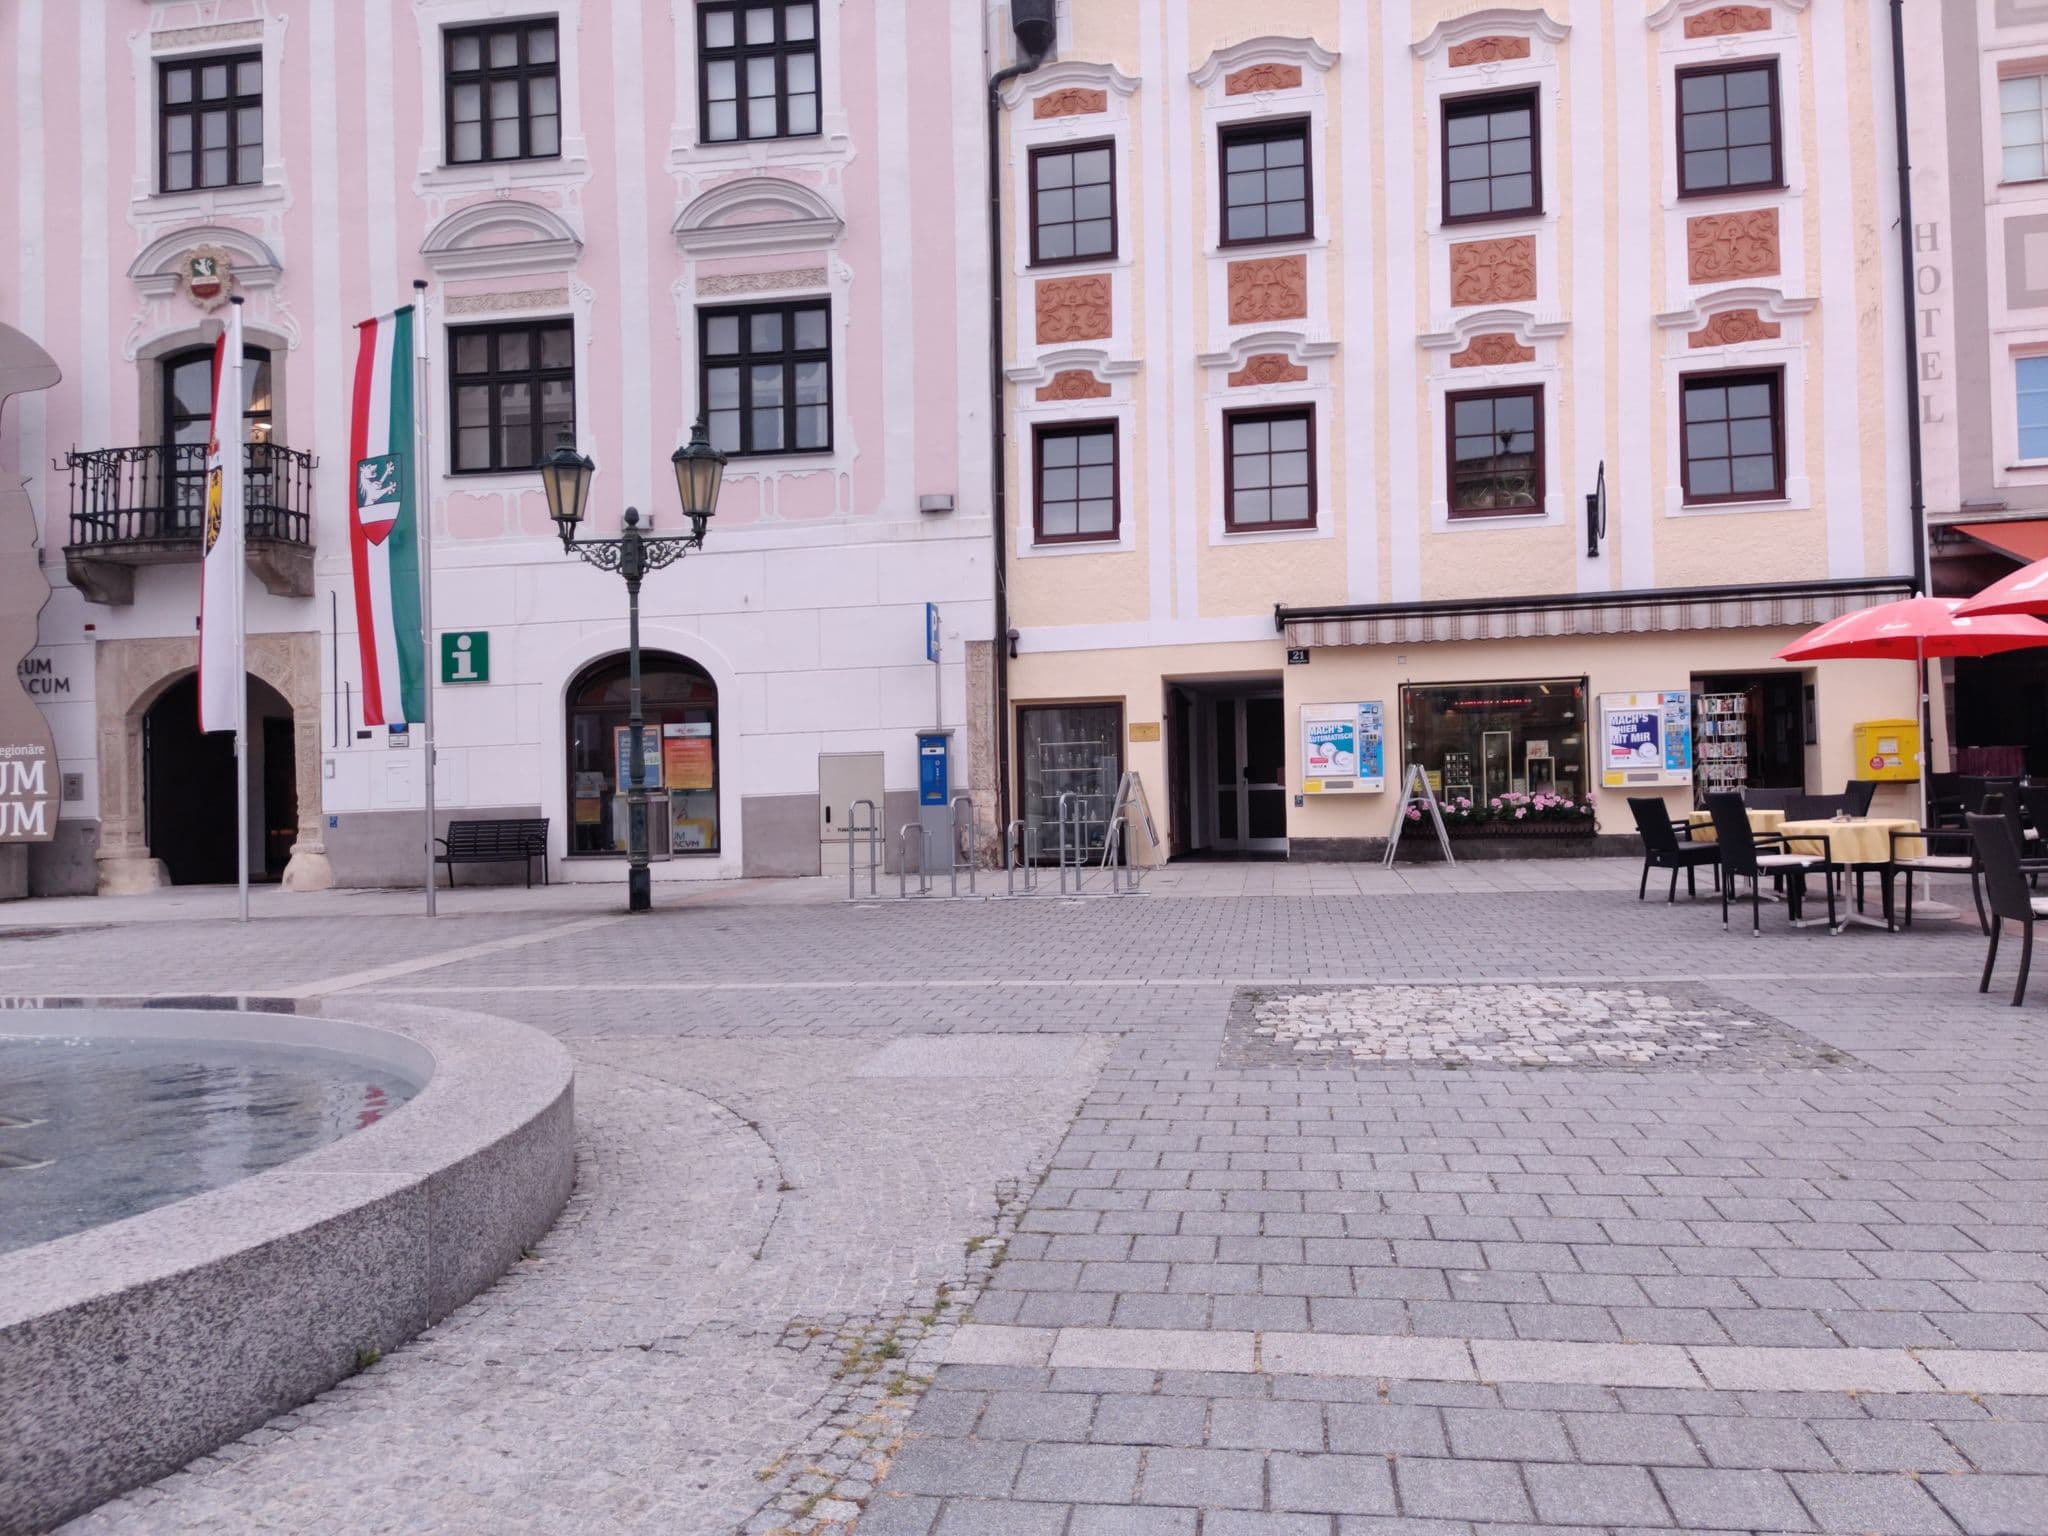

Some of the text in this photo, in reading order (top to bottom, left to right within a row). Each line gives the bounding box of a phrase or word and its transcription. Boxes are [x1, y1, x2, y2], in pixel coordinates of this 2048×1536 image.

[1915, 222, 1945, 424] HOTEL
[1292, 650, 1304, 660] 21
[1609, 712, 1649, 726] MACH'S
[1308, 723, 1344, 736] MACH'S
[1630, 732, 1651, 743] MIR
